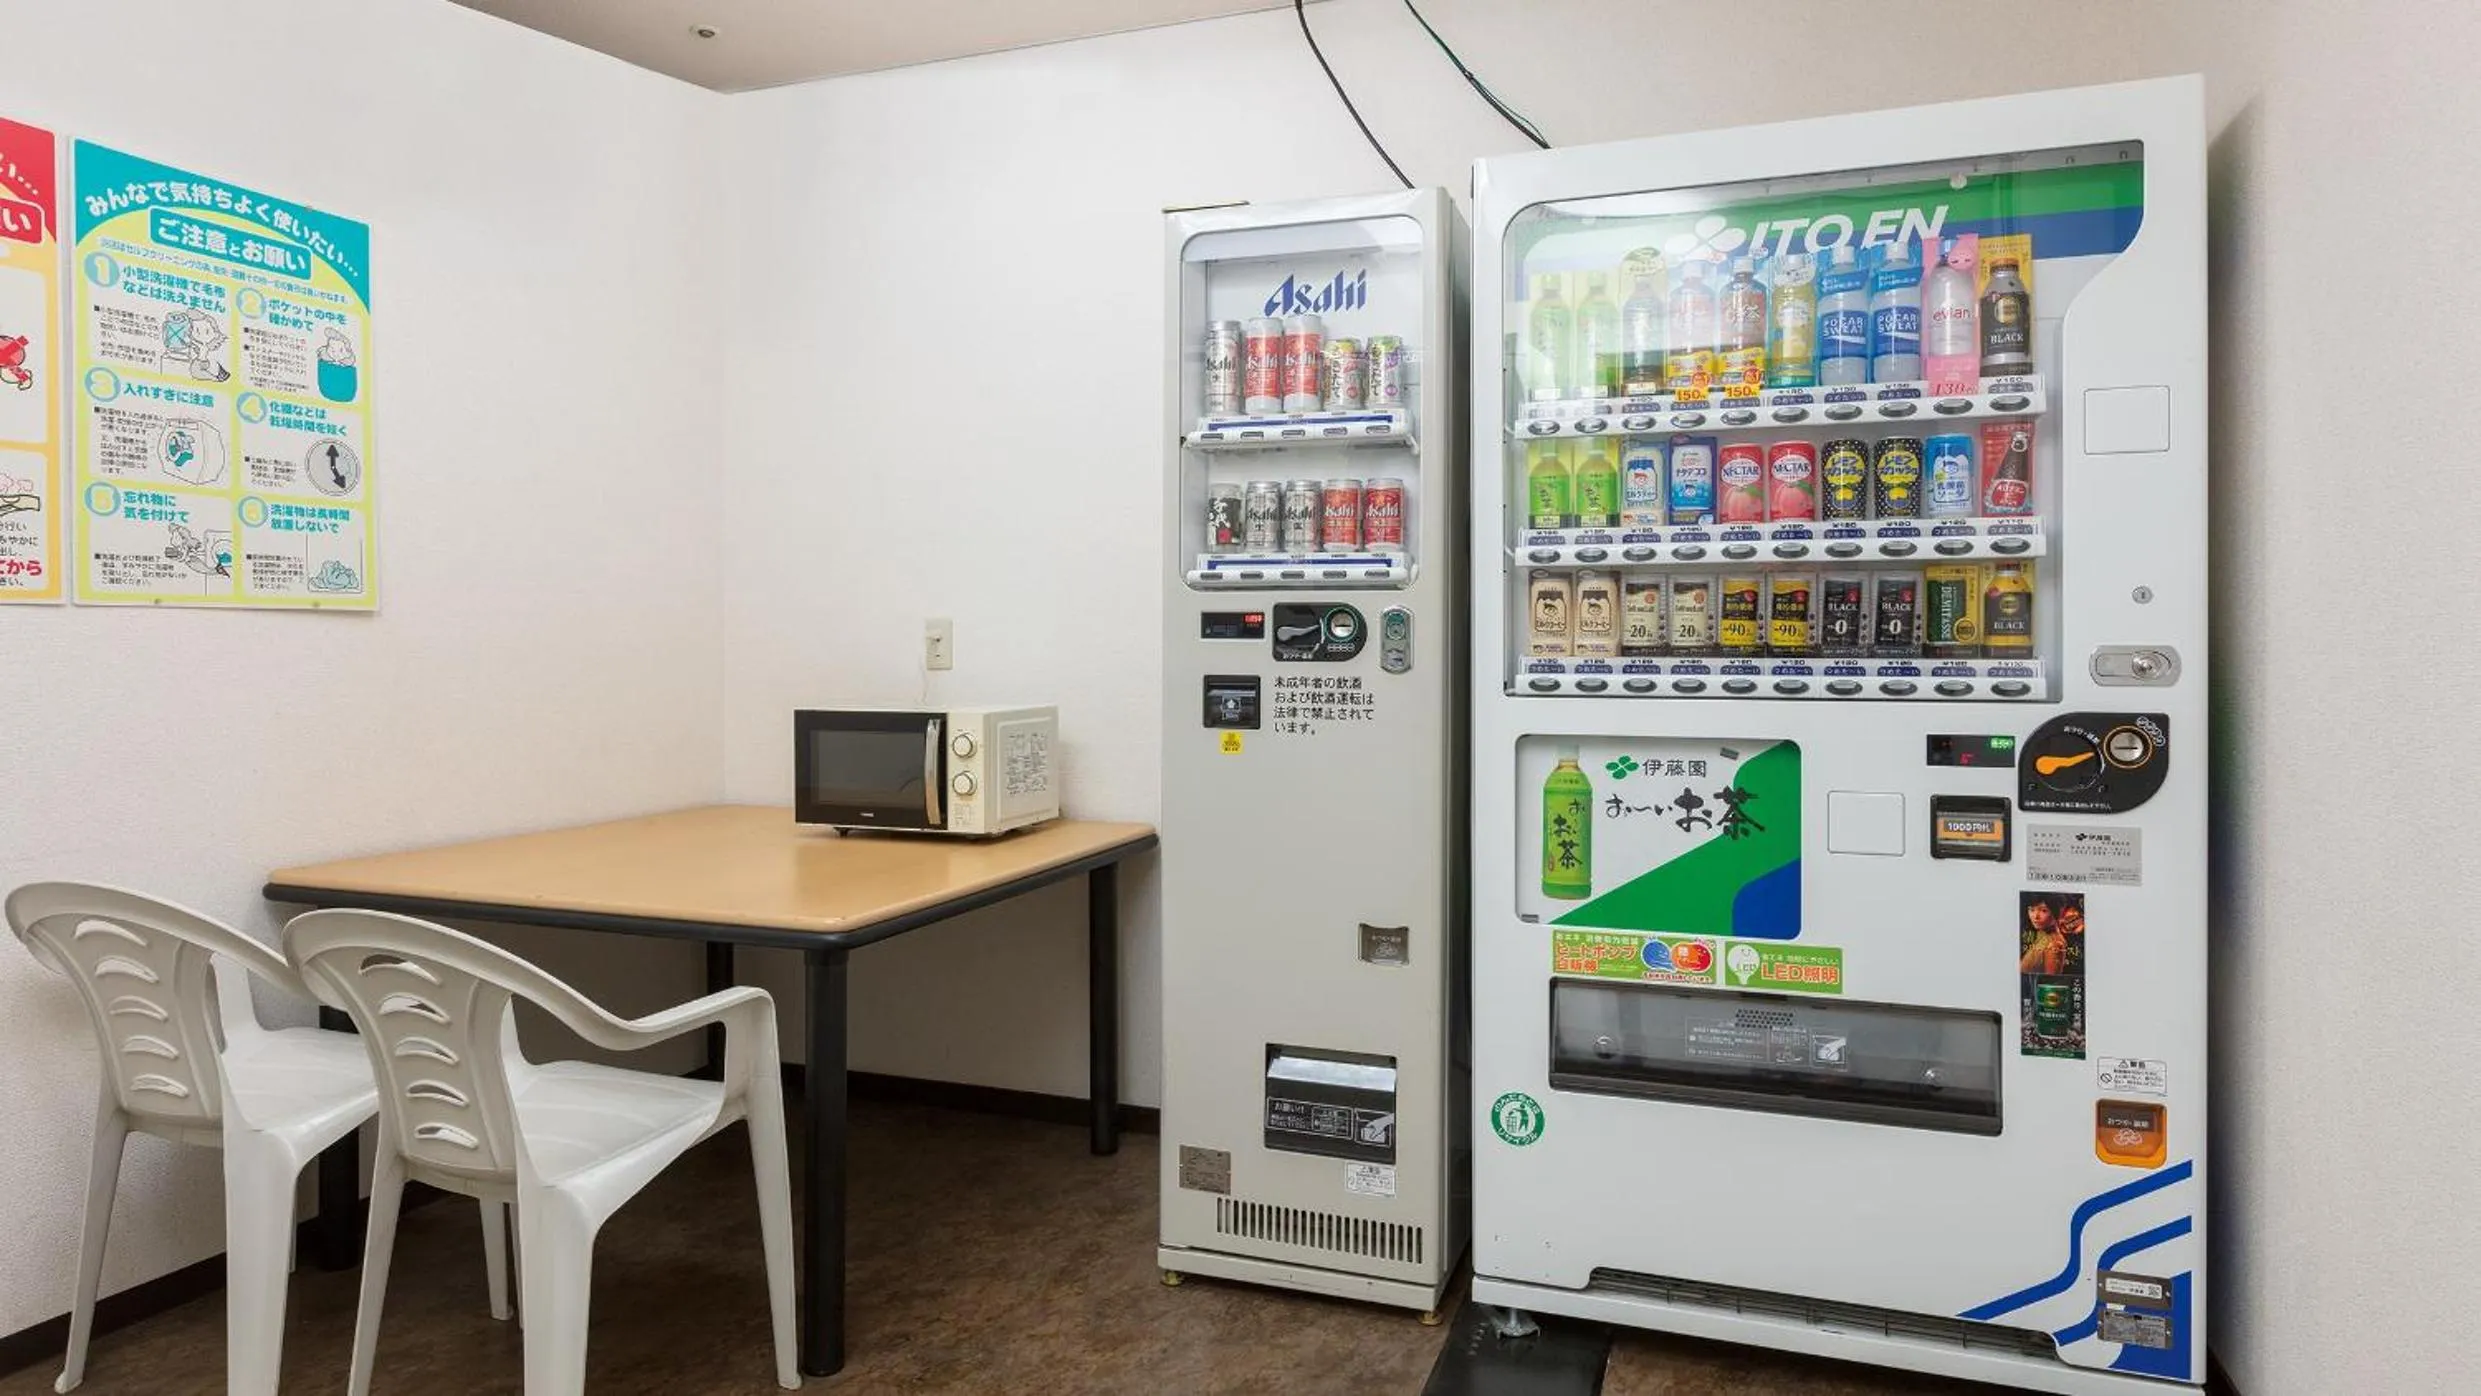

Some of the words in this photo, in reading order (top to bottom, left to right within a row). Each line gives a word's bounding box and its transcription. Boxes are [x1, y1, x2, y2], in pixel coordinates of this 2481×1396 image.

[1748, 213, 1854, 258] ITO
[1862, 205, 1950, 253] EN
[158, 217, 307, 271] ご注意とお願い
[1264, 268, 1367, 317] Asahi
[269, 299, 347, 325] ポケットの中を
[1990, 333, 2024, 345] BLACK
[124, 383, 214, 408] 入れすぎに注意
[1722, 465, 1760, 477] NECTAR
[1773, 462, 1811, 473] NECTAR
[124, 491, 176, 507] 忘れ物に
[124, 507, 189, 523] 気を付けて
[1827, 602, 1858, 611] BLACK
[1881, 602, 1911, 611] BLACK
[1835, 619, 1848, 635] 0
[1889, 619, 1902, 635] 0
[1993, 620, 2025, 630] BLACK
[1274, 676, 1362, 689] 未成年者の飲酒
[1274, 691, 1374, 705] および飲酒運転は
[1273, 707, 1374, 721] 法律で禁止されて
[1274, 722, 1316, 735] います。
[1642, 757, 1707, 778] 伊藤園
[1556, 943, 1637, 960] ヒートポンプ
[1761, 963, 1840, 984] LED照明
